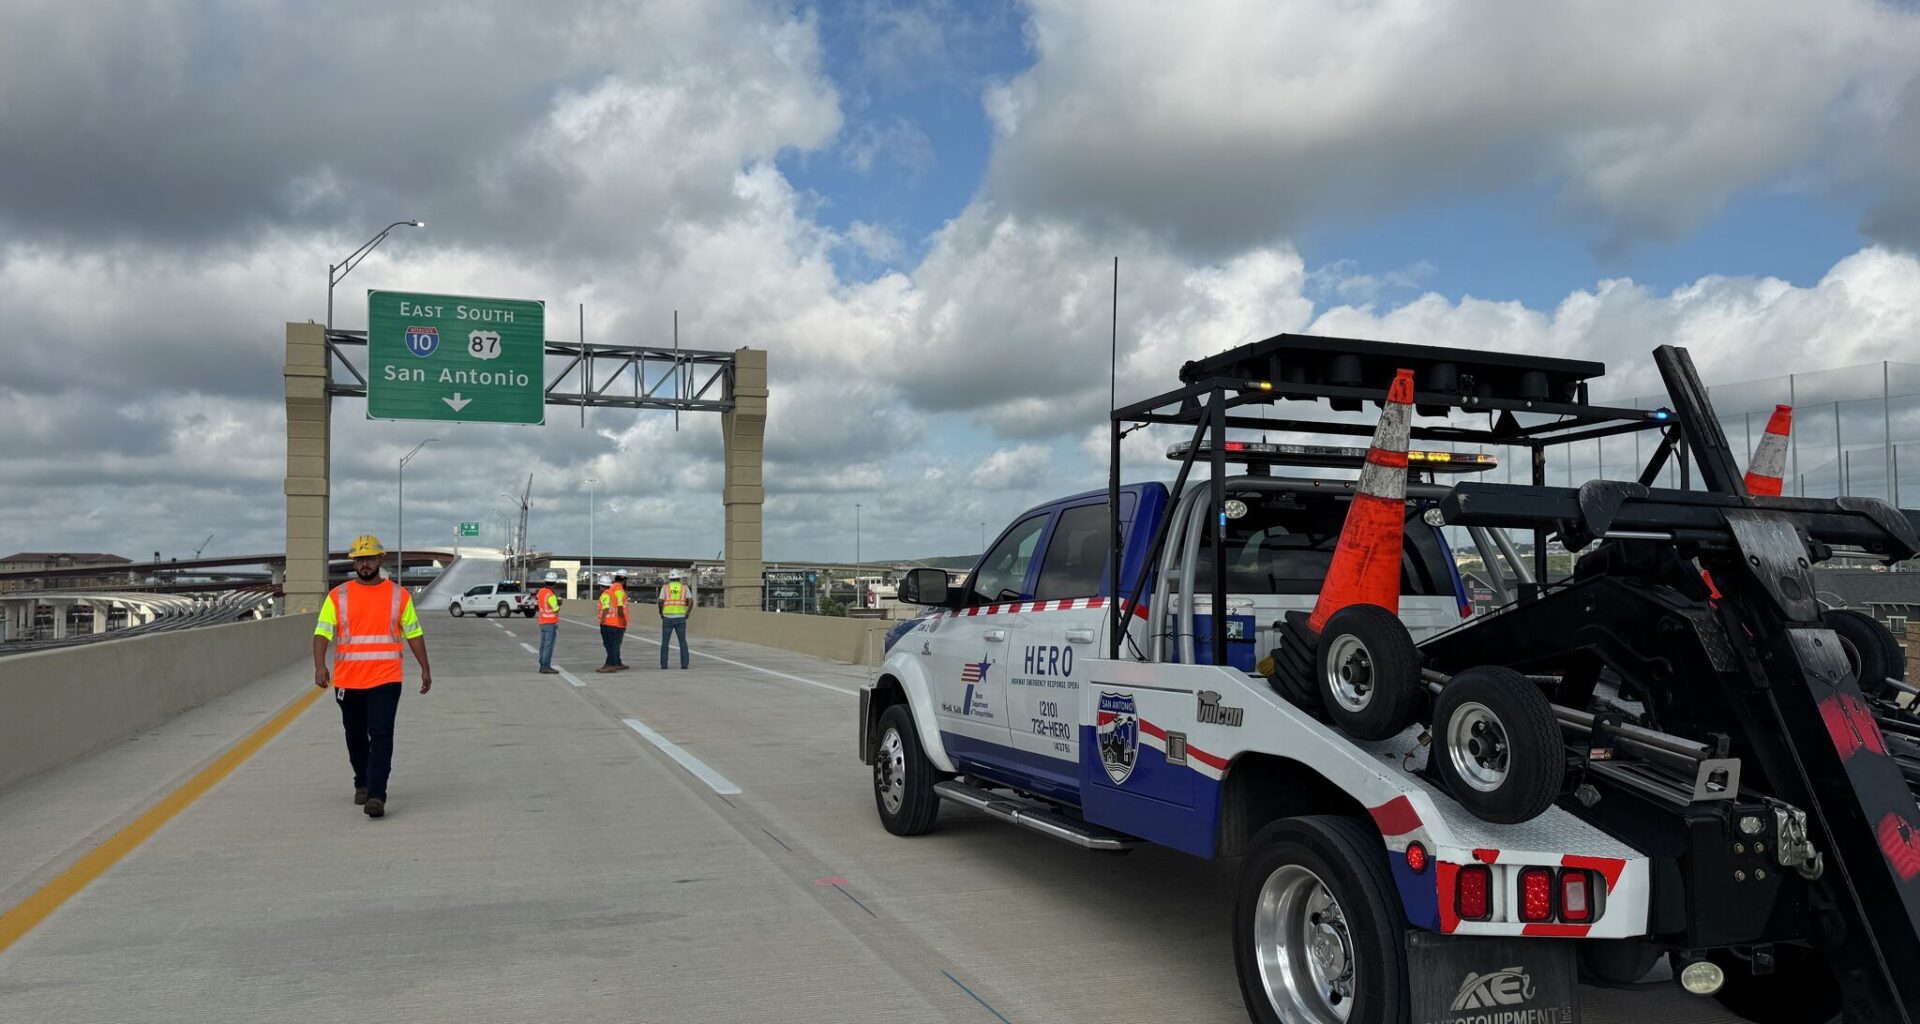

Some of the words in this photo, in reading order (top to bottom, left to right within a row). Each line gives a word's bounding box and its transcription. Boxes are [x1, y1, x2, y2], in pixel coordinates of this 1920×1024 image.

[400, 302, 444, 318] EAST
[456, 305, 514, 323] SOUTH
[412, 334, 432, 351] 10
[471, 336, 498, 353] 87
[384, 365, 425, 382] San
[439, 368, 529, 387] Antonio
[1024, 645, 1073, 678] HERO
[1047, 680, 1066, 689] RESPONSE
[1039, 700, 1058, 718] (210)
[1101, 699, 1112, 709] SAN
[1112, 700, 1135, 712] ANTONIO
[1031, 718, 1070, 740] 732-HERO
